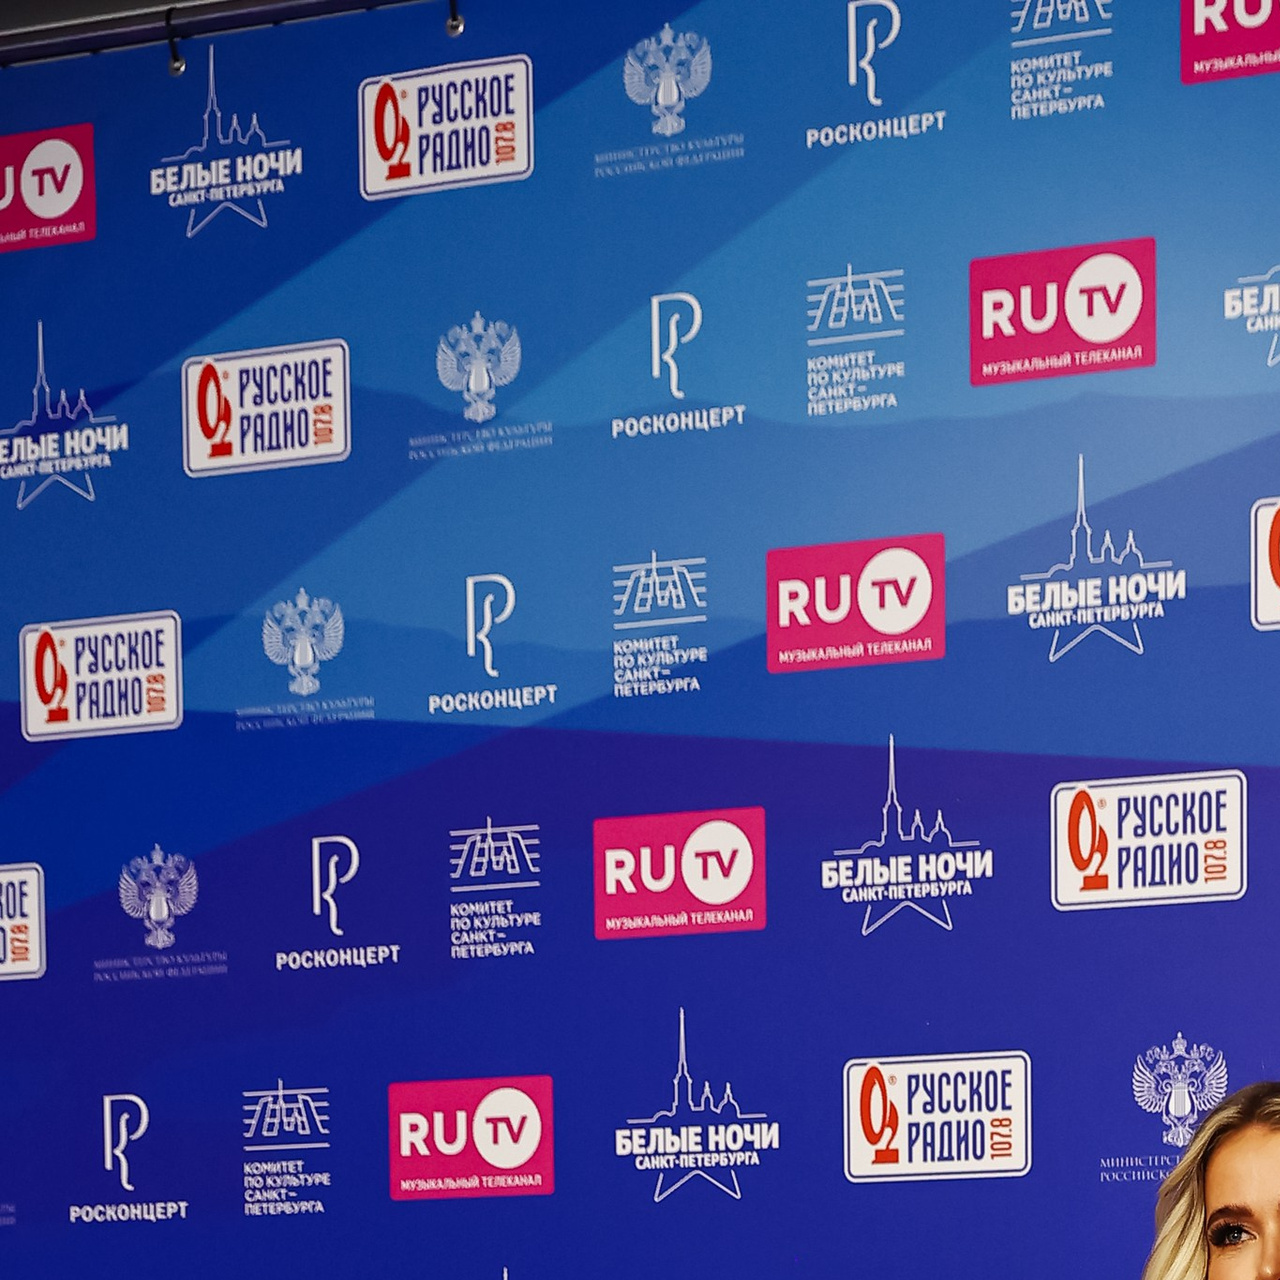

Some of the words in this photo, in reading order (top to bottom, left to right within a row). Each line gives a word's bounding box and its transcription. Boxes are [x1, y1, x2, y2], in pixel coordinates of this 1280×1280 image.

[417, 73, 515, 128] РУССКОЕ
[805, 111, 946, 149] РОСКОНЦЕРТ
[417, 124, 490, 176] РАДИО
[982, 350, 1072, 376] МУЗЫКАЛЬНЫЙ
[1074, 344, 1143, 365] ТЕЛЕКАНАЛ
[238, 357, 333, 408] РУССКОЕ
[239, 407, 309, 455] РАДИО
[611, 405, 746, 439] РОСКОНЦЕРТ
[1007, 577, 1102, 615] БЕЛЫЕ
[1108, 569, 1186, 606] НОЧИ
[1028, 601, 1164, 629] САНКТ-ПЕТЕРБУРГА
[778, 640, 864, 663] МУЗЫКАЛЬНЫЙ
[867, 636, 932, 655] ТЕЛЕКАНАЛ
[428, 685, 557, 714] РОСКОНЦЕРТ
[1117, 790, 1227, 840] РУССКОЕ
[821, 854, 912, 889] БЕЛЫЕ
[918, 848, 993, 883] НОЧИ
[1117, 842, 1199, 890] РАДИО
[842, 879, 972, 904] САНКТ-ПЕТЕРБУРГА
[605, 909, 688, 930] МУЗЫКАЛЬНЫЙ
[690, 908, 753, 925] ТЕЛЕКАНАЛ
[276, 945, 401, 970] РОСКОНЦЕРТ
[906, 1069, 1012, 1115] РУССКОЕ
[615, 1124, 702, 1156] БЕЛЫЕ
[708, 1121, 779, 1152] НОЧИ
[907, 1119, 985, 1164] РАДИО
[635, 1150, 760, 1171] САНКТ-ПЕТЕРБУРГА
[69, 1202, 189, 1223] РОСКОНЦЕРТ
